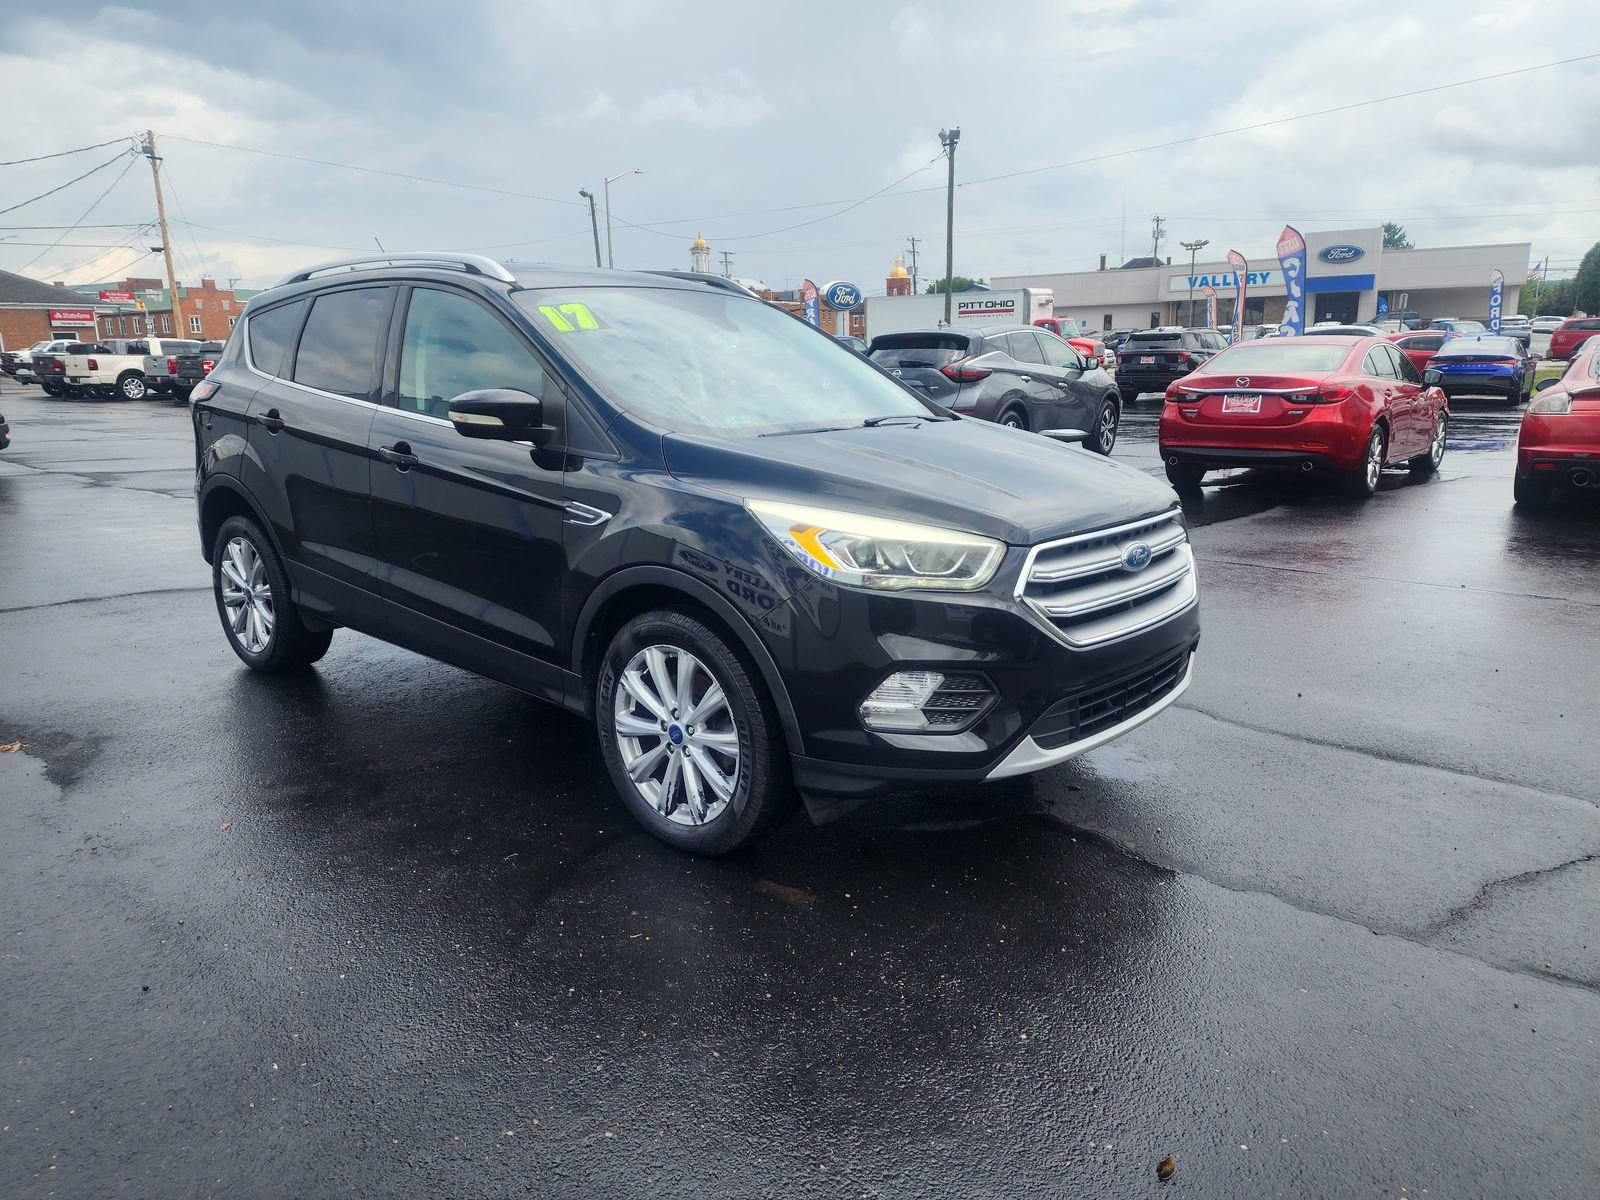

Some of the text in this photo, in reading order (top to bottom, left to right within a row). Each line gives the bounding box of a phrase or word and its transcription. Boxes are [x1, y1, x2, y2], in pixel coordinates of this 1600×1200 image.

[1328, 248, 1355, 259] Ford
[1187, 272, 1271, 288] VALLRY
[834, 286, 856, 304] Ford
[958, 300, 1015, 309] PITT OHIO
[538, 303, 599, 333] 17
